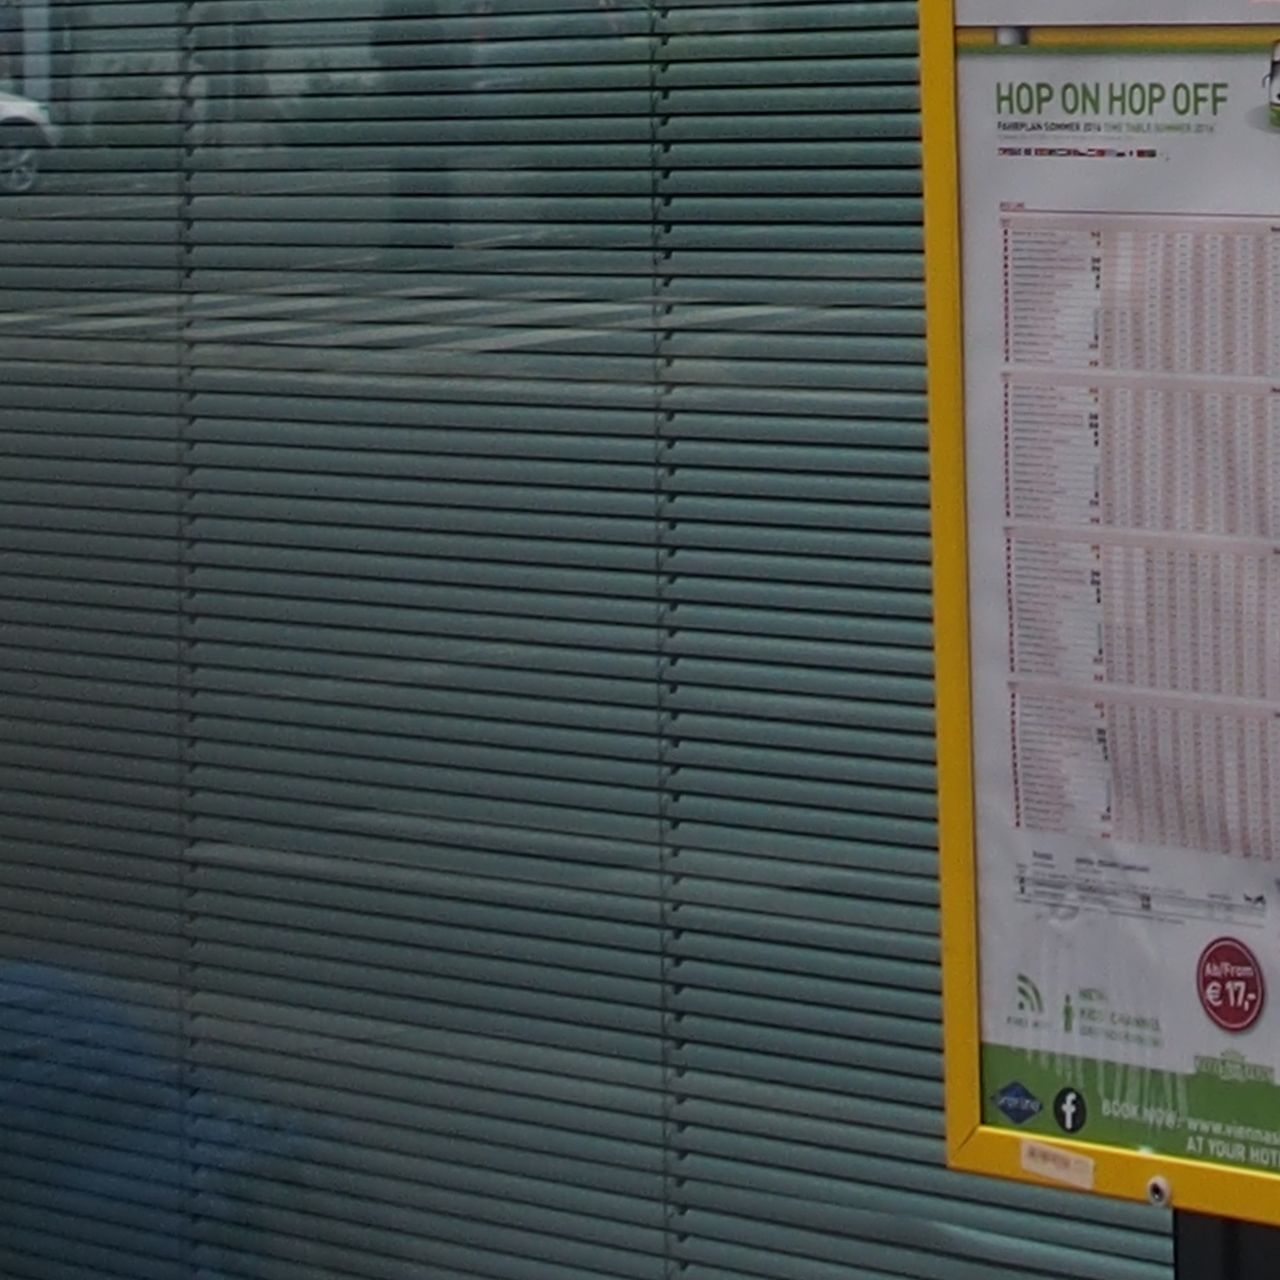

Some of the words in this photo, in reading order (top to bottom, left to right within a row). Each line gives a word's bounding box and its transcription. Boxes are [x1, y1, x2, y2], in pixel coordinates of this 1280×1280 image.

[996, 82, 1054, 116] HOP
[1061, 82, 1100, 116] ON
[1108, 83, 1166, 116] HOP
[1172, 83, 1229, 117] OFF
[1101, 1099, 1139, 1119] BOOK
[1186, 1136, 1204, 1153] AT
[1208, 1139, 1246, 1162] YOUR
